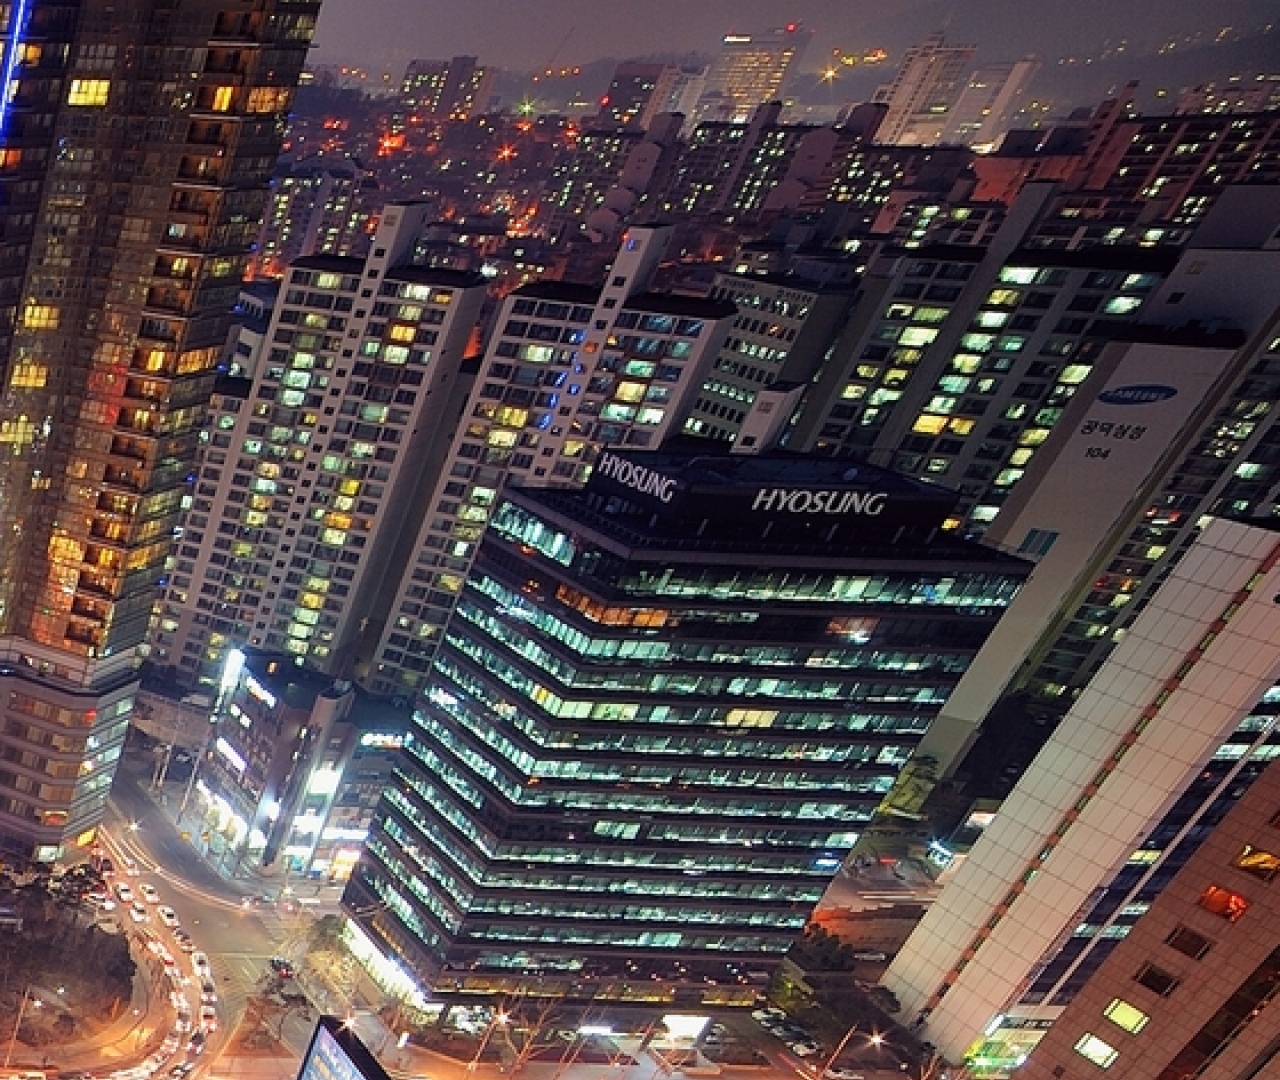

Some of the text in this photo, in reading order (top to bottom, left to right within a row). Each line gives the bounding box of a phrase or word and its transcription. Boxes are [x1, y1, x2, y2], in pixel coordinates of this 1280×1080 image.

[1084, 447, 1112, 459] 104
[598, 452, 678, 504] HYOSUNG
[751, 488, 888, 516] HYOSUNG
